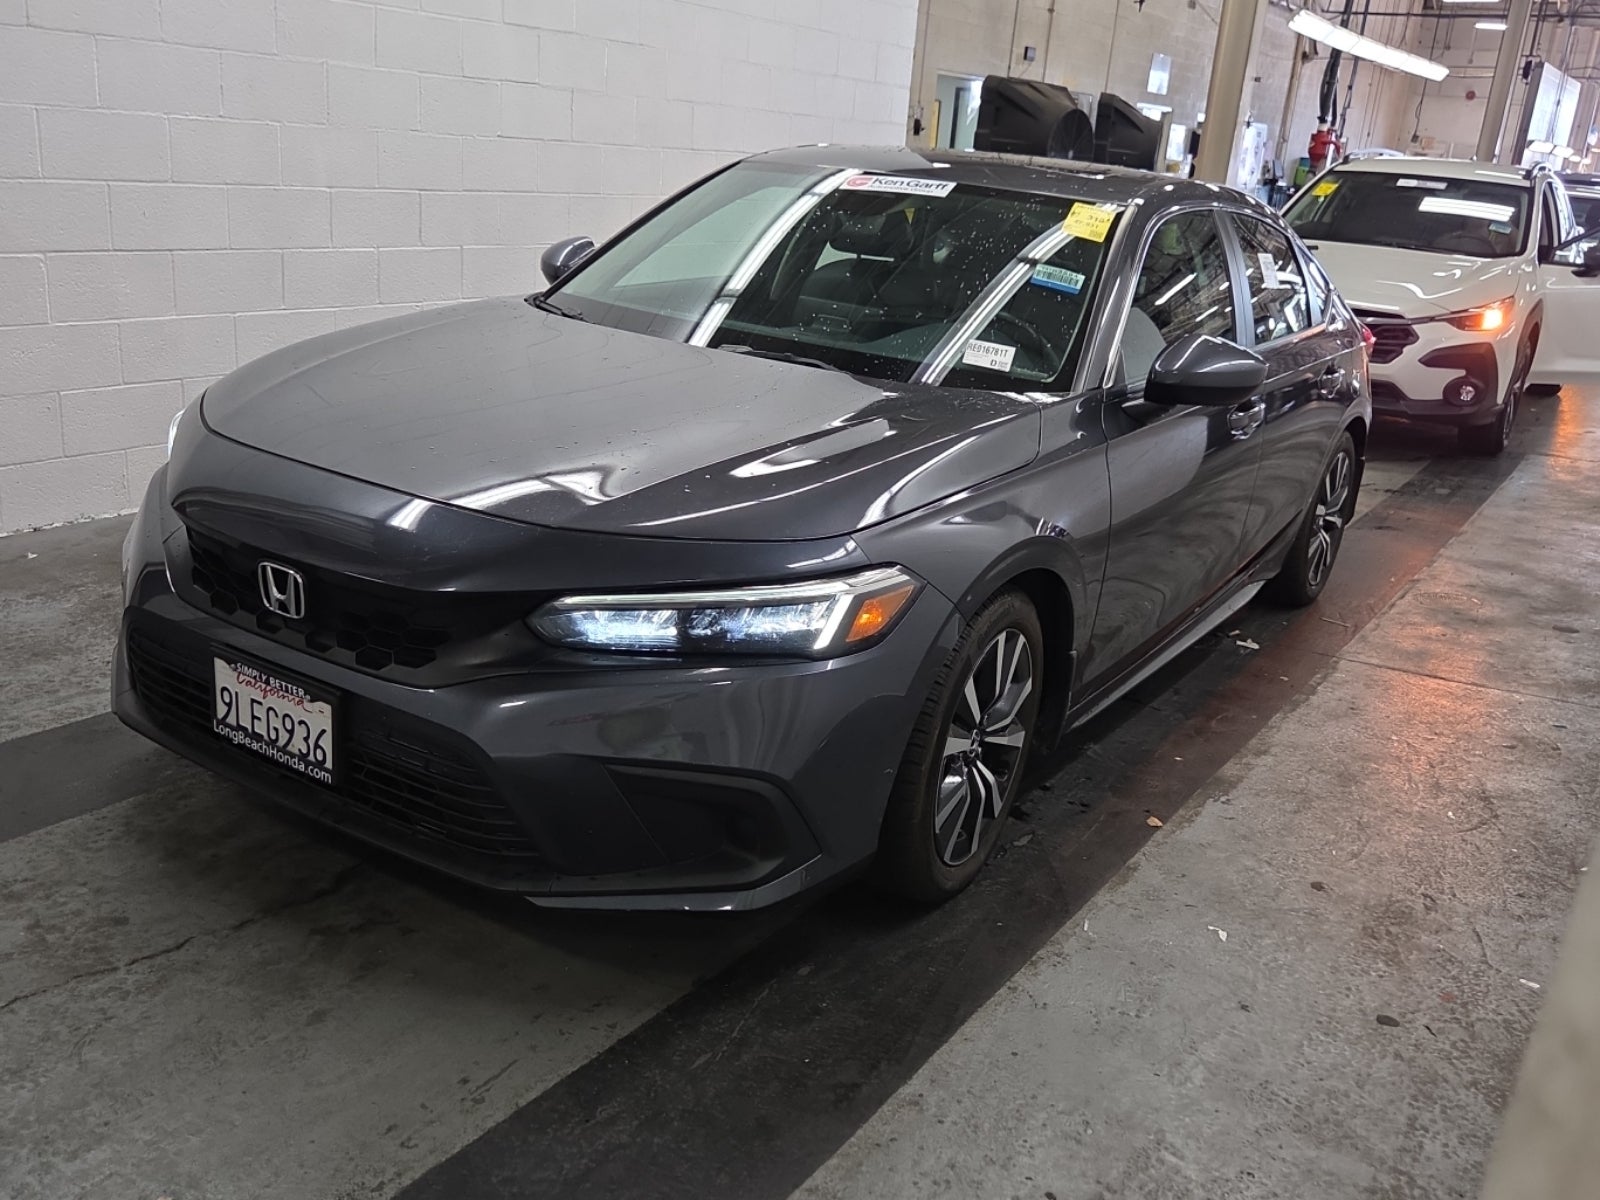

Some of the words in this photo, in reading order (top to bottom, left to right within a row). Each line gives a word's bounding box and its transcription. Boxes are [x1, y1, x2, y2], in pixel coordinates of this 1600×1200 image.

[872, 177, 904, 186] Ken
[906, 179, 949, 190] Garff
[236, 662, 268, 683] SIMPLY
[269, 677, 306, 699] BETTER
[220, 685, 328, 767] 9LEG936
[213, 719, 332, 785] LongBeachHonda.com
